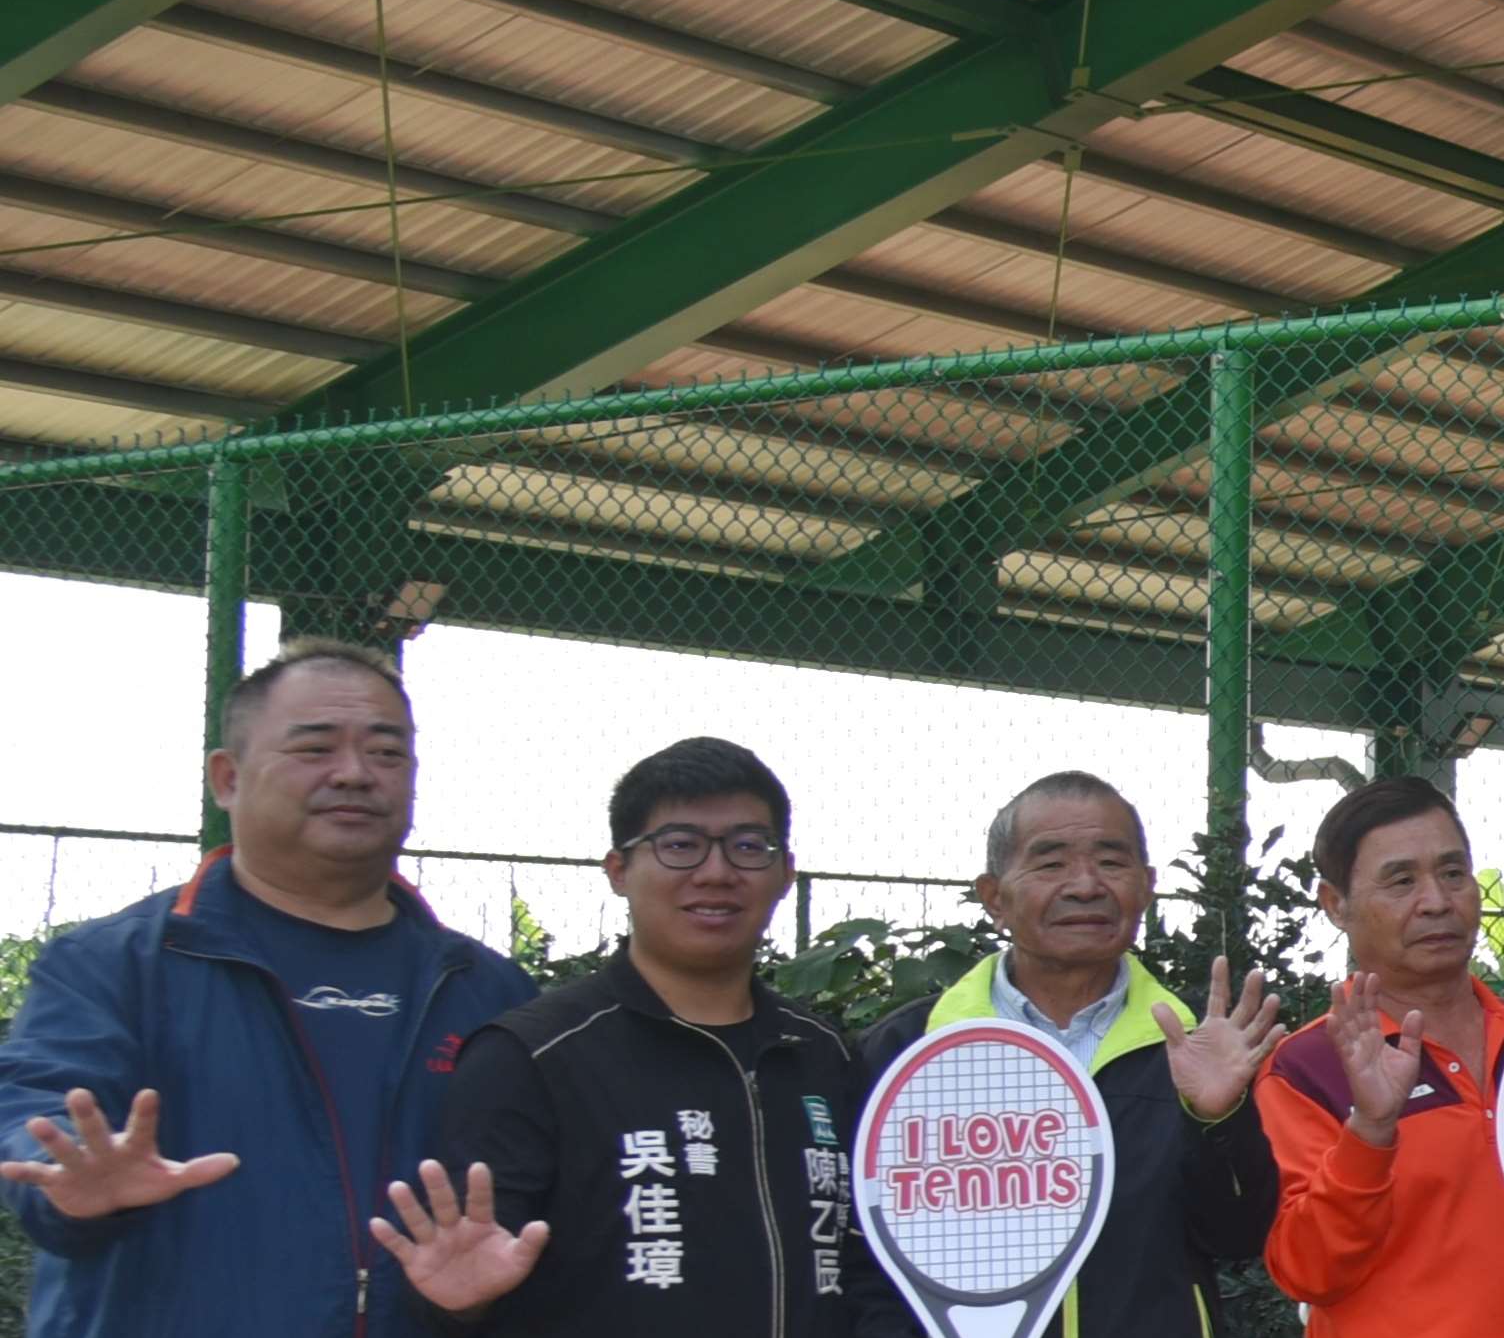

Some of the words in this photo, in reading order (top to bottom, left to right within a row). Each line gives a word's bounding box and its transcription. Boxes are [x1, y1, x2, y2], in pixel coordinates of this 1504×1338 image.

[677, 1109, 720, 1176] 秘書
[905, 1117, 923, 1161] I
[620, 1130, 685, 1289] 吳佳璋
[804, 1147, 843, 1295] 陳乙辰
